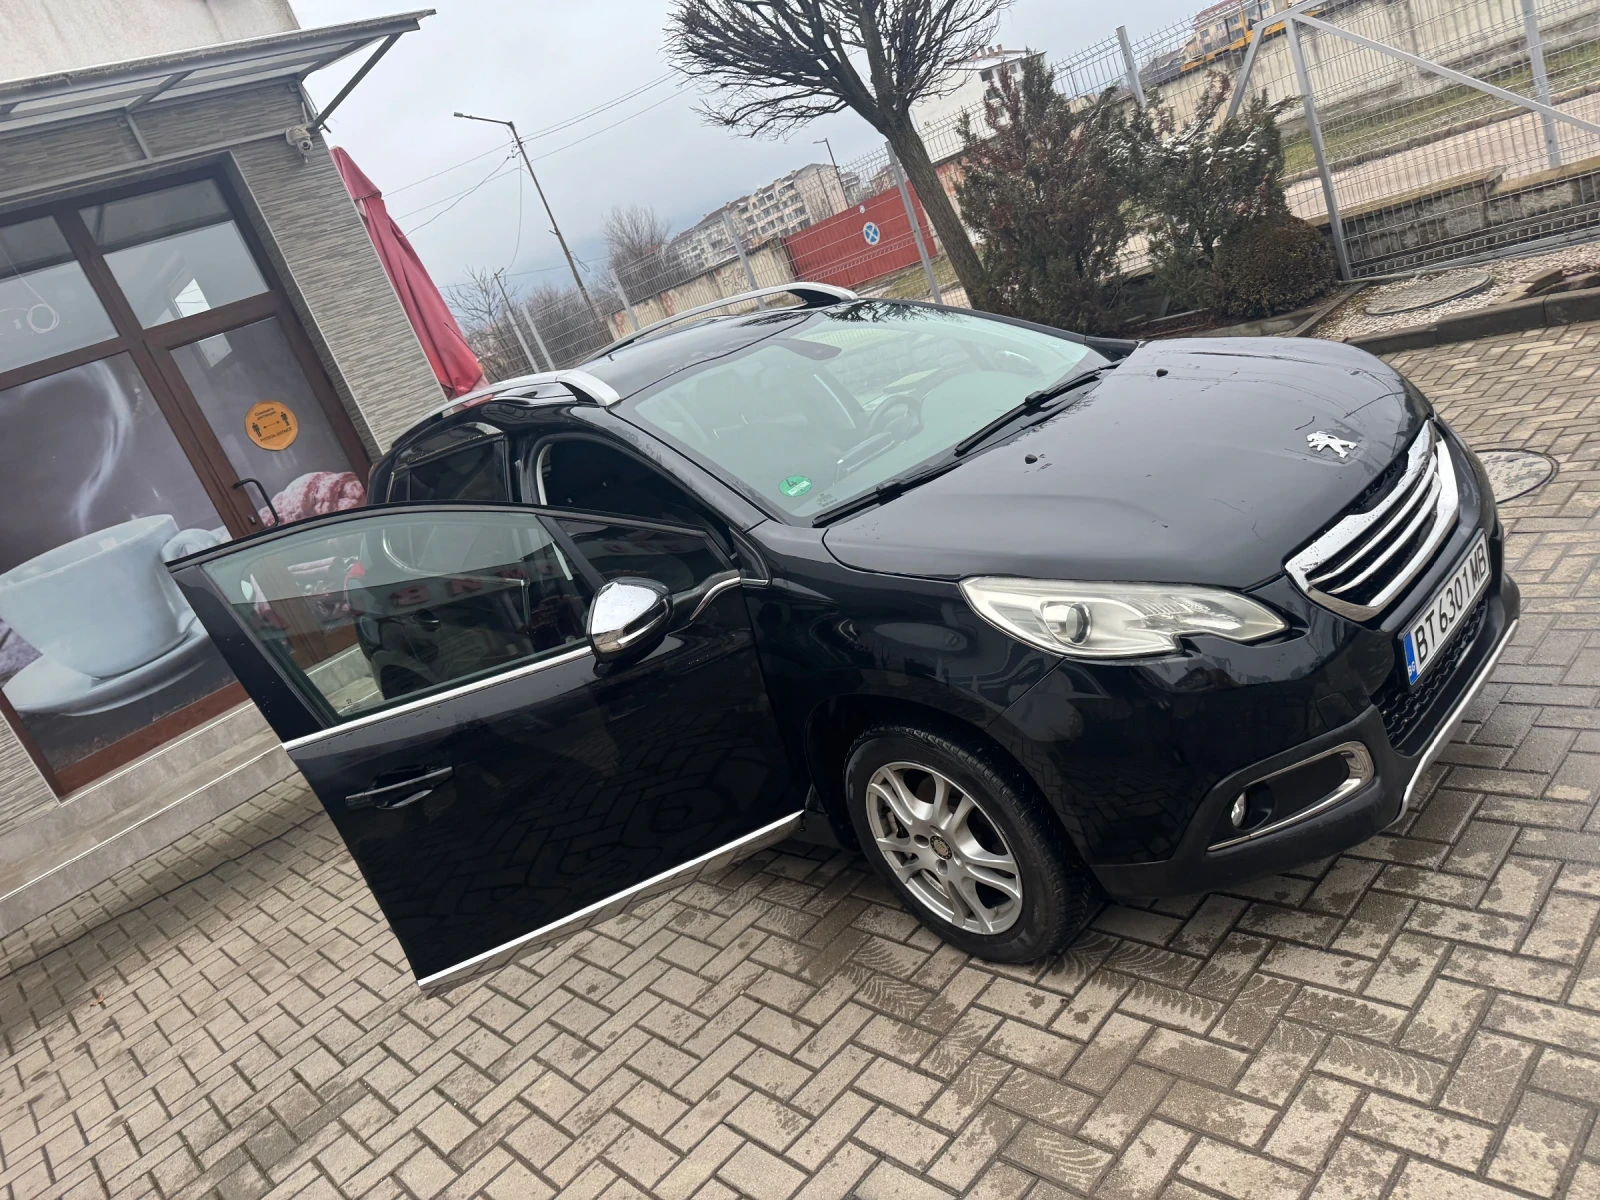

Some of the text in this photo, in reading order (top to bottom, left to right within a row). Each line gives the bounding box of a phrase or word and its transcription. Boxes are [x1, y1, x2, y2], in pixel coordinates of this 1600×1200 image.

[1414, 543, 1487, 665] BT 6301 MB
[1407, 661, 1416, 677] BG
